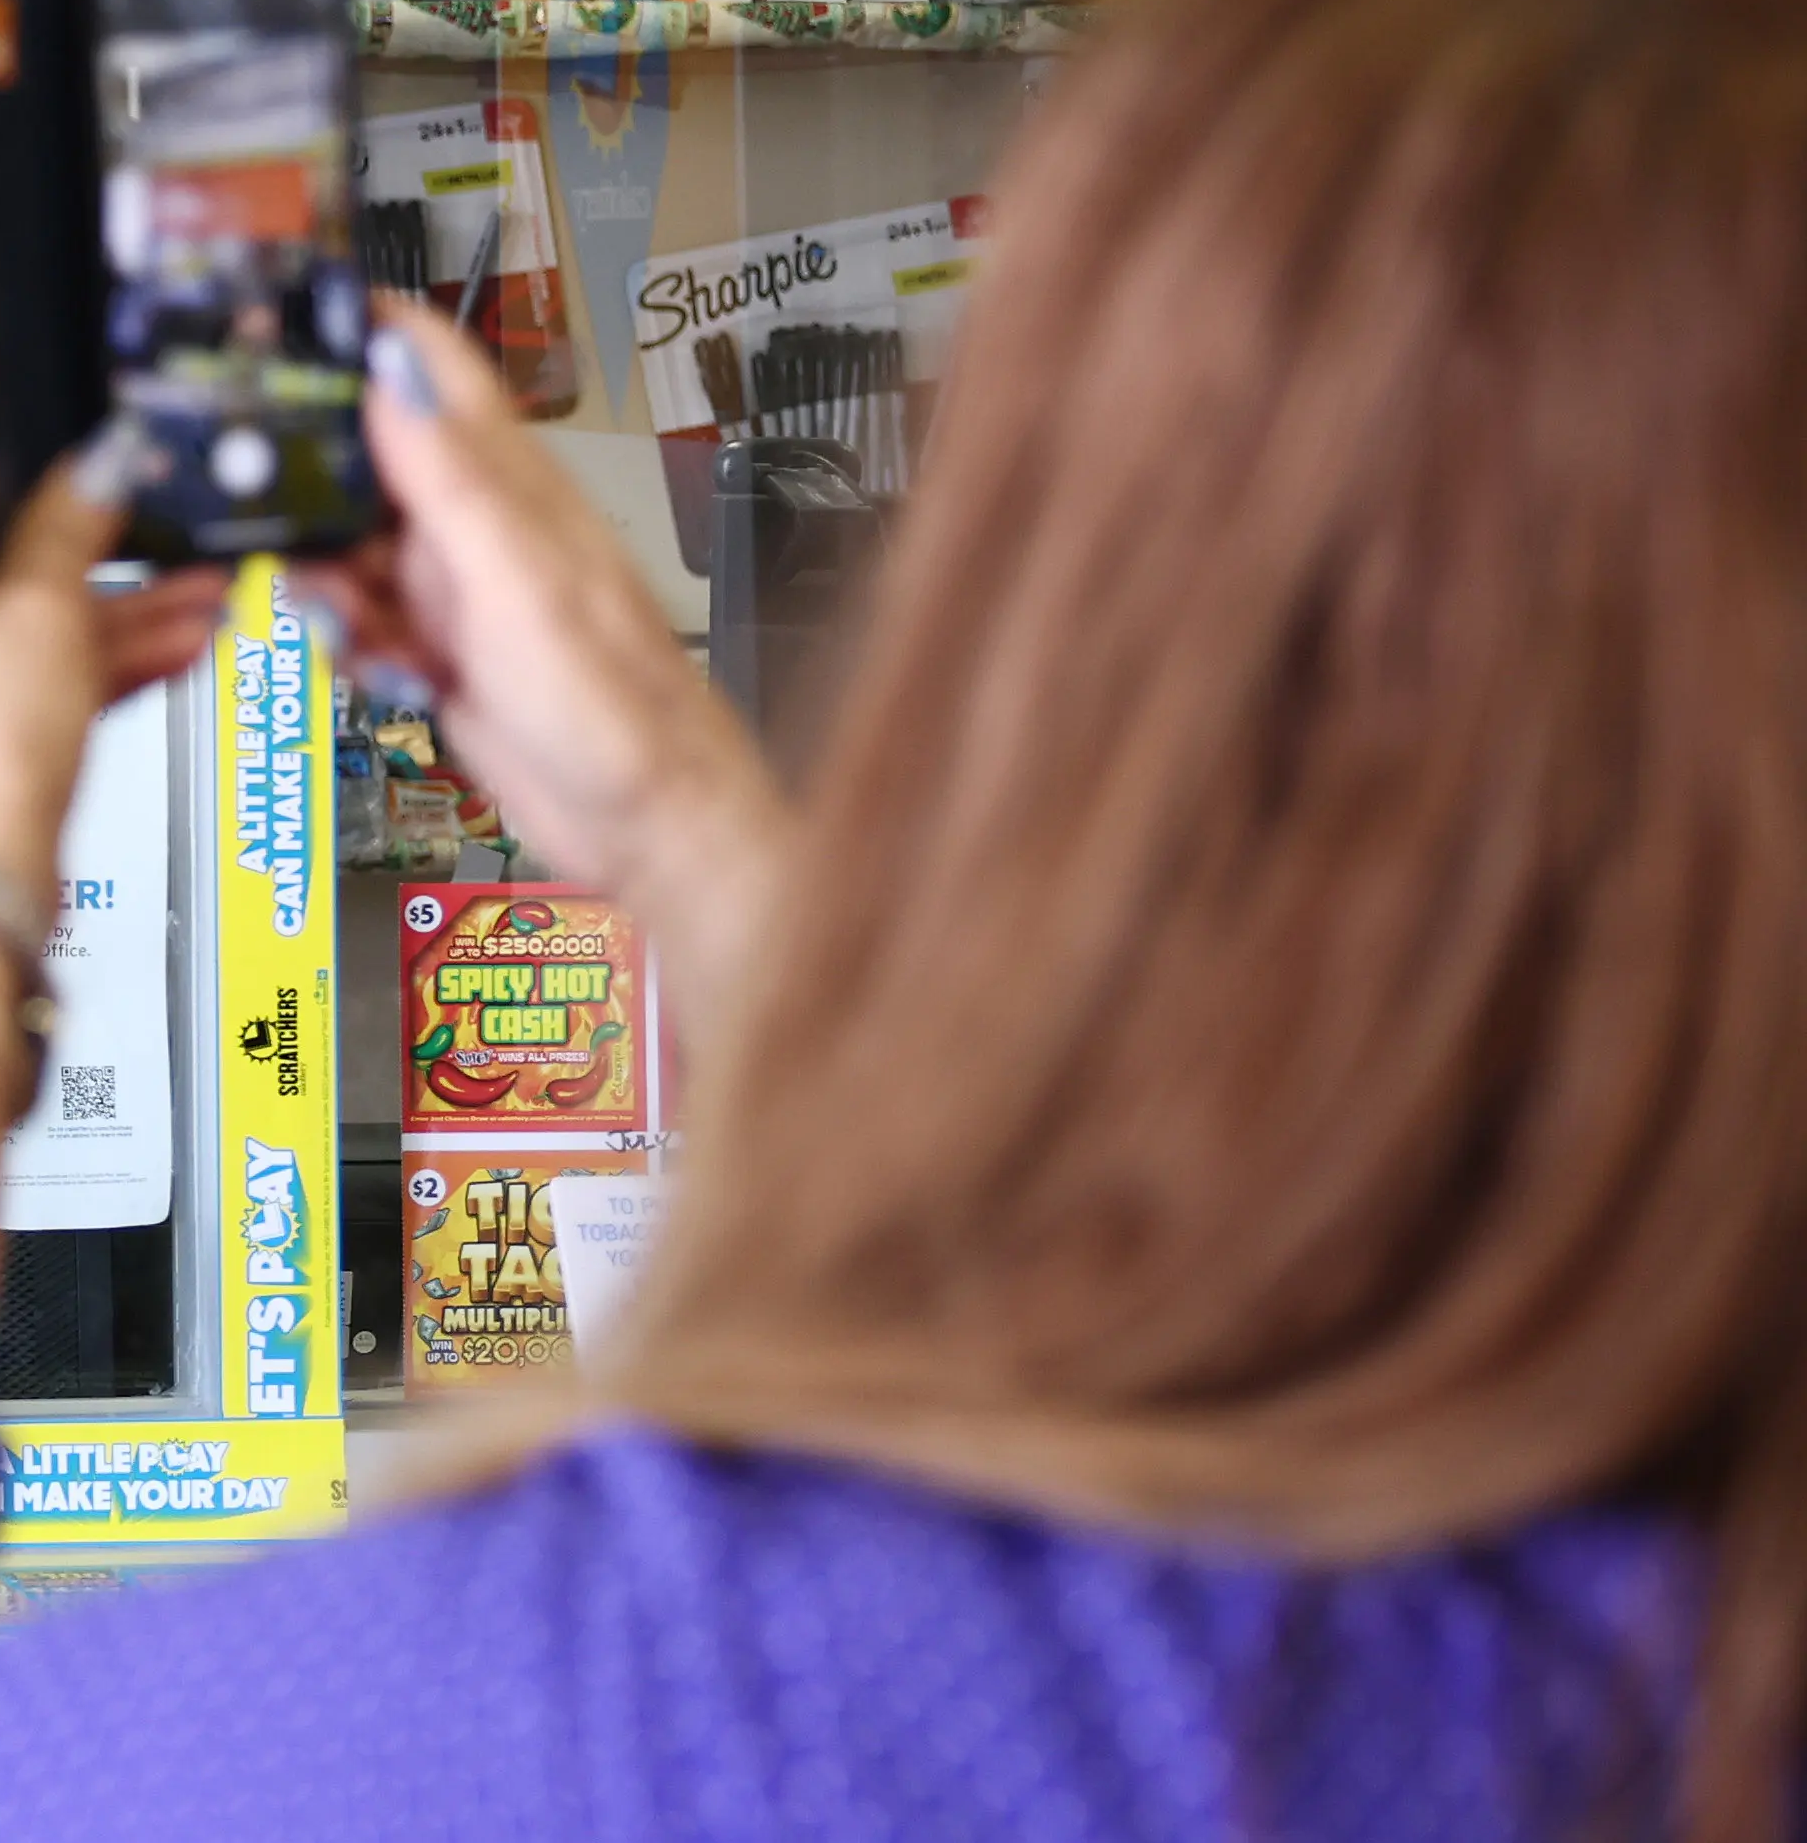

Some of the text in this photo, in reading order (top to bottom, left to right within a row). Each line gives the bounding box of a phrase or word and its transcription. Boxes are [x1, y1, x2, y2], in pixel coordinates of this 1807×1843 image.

[639, 235, 837, 350] Sharpie
[409, 903, 434, 925] $5
[483, 935, 605, 957] $250,000!
[438, 963, 612, 1004] SPICY HOT
[481, 1006, 568, 1045] CASH
